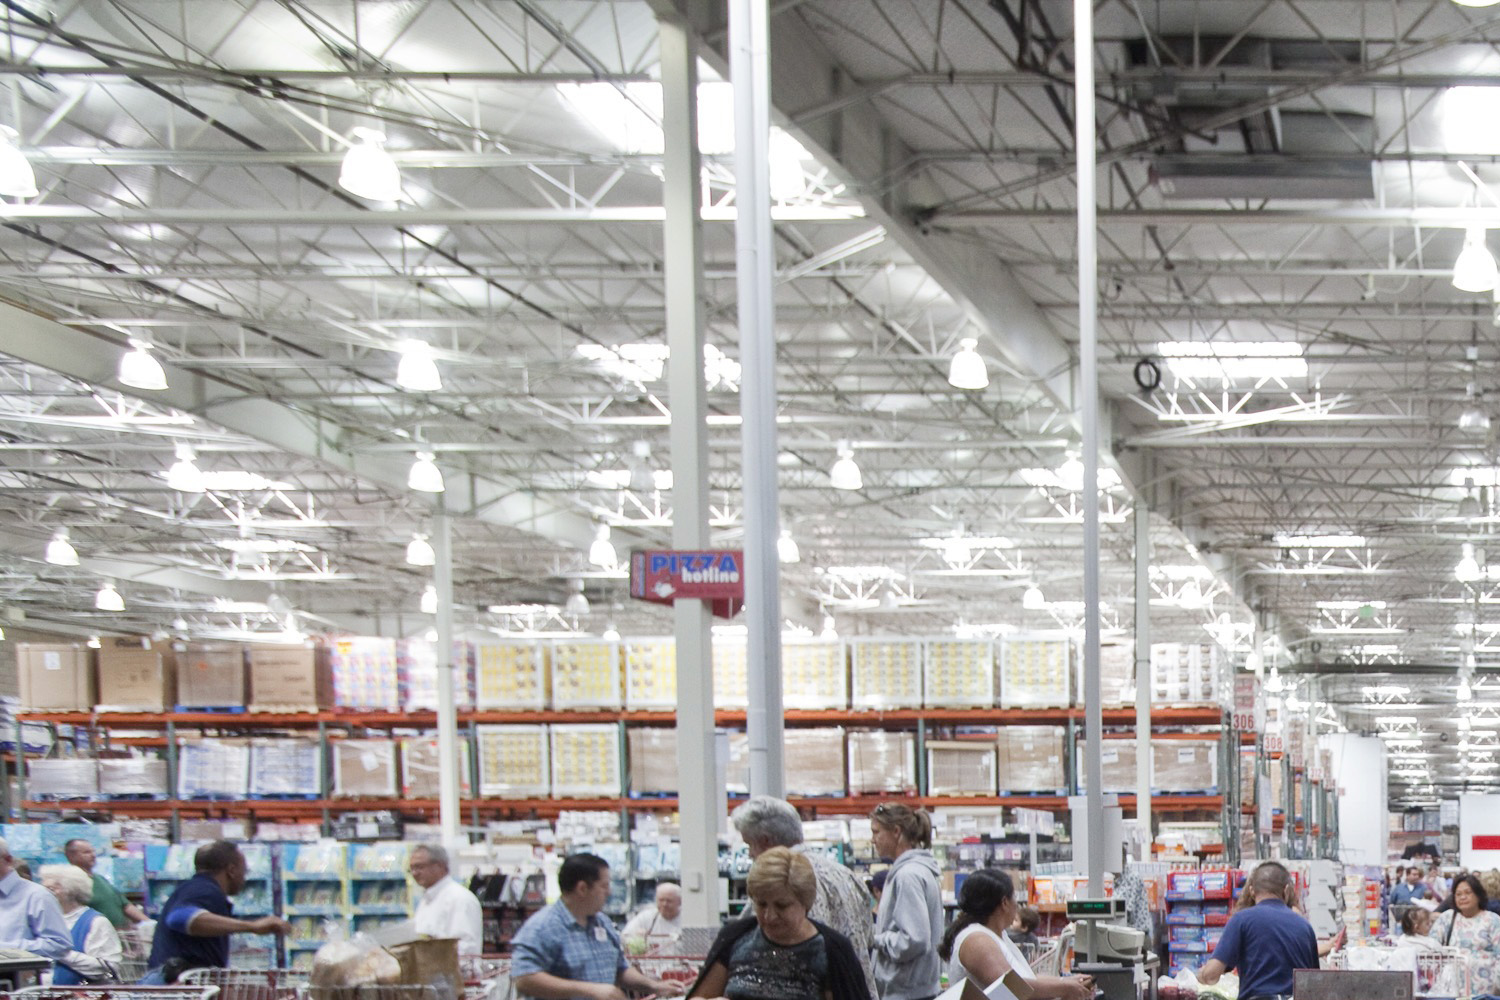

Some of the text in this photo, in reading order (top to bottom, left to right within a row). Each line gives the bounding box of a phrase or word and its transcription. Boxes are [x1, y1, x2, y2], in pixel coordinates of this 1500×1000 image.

[651, 555, 738, 574] PIZZA
[681, 566, 739, 583] hotline
[1233, 714, 1254, 729] 306
[1265, 737, 1282, 749] 308
